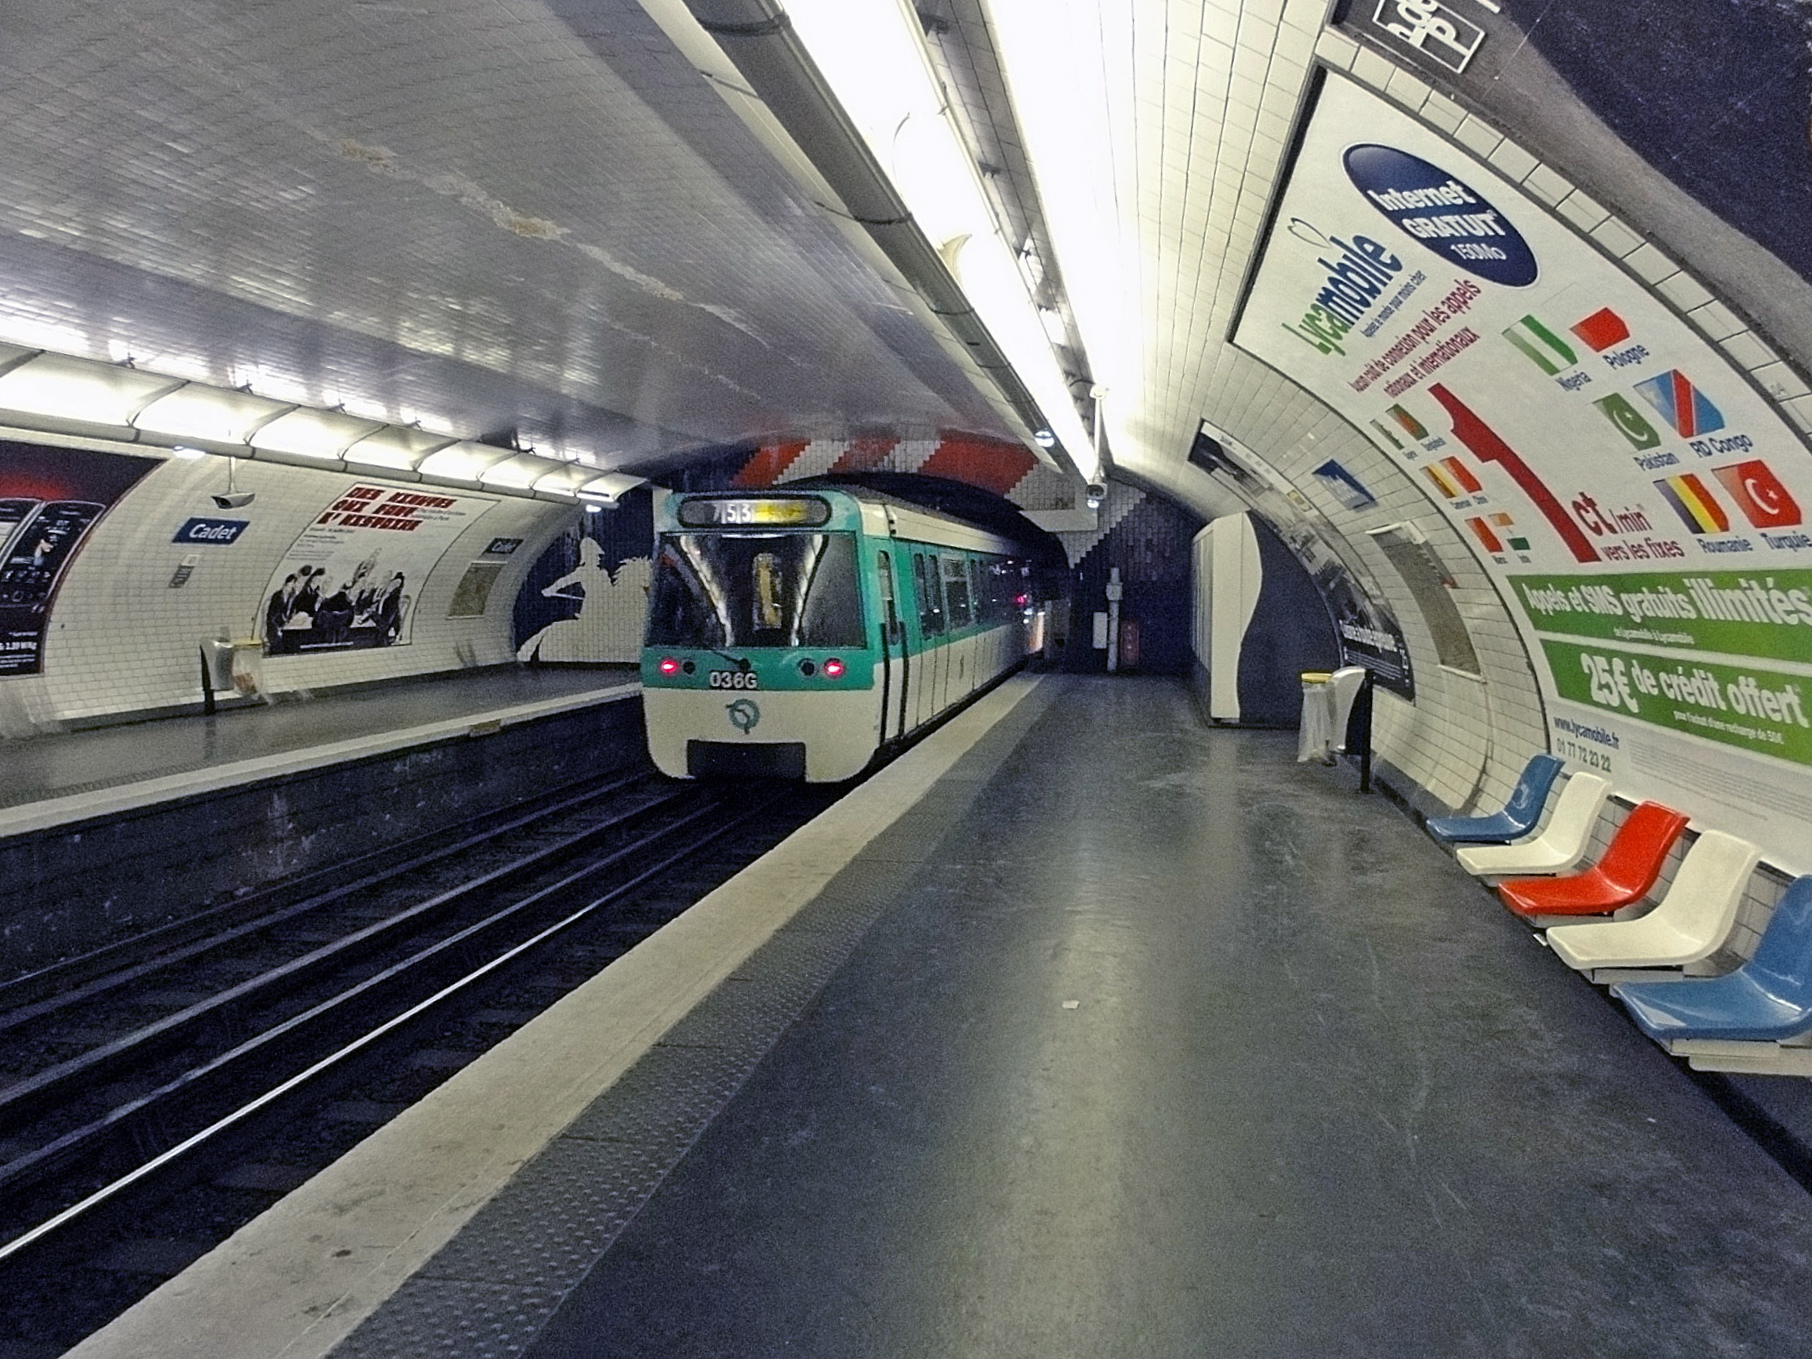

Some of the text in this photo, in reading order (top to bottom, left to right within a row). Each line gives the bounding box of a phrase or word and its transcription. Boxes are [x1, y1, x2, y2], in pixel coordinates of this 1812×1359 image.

[1367, 181, 1477, 211] Internet
[1402, 213, 1505, 238] GRATUIT
[1451, 243, 1507, 260] 150Mo
[1281, 235, 1403, 356] Lycamobile
[1441, 279, 1481, 314] appels
[1422, 307, 1451, 326] les
[1411, 317, 1437, 344] pour
[1413, 326, 1480, 375] internationaux
[1602, 344, 1650, 370] Pologne
[1371, 359, 1390, 372] de
[1409, 363, 1427, 379] et
[1689, 433, 1754, 459] RD Congo
[1633, 450, 1681, 472] Pakistan
[189, 523, 237, 539] Cadet
[1760, 530, 1812, 552] Turquie
[1600, 537, 1685, 561] vers les fixes
[1696, 536, 1753, 554] Roumanie
[1522, 576, 1812, 626] Appels et SMS gratuits illimités
[710, 671, 758, 689] 036G
[1580, 653, 1810, 729] 25€ de crédit offert
[1567, 741, 1576, 758] 77
[1577, 745, 1588, 763] 72
